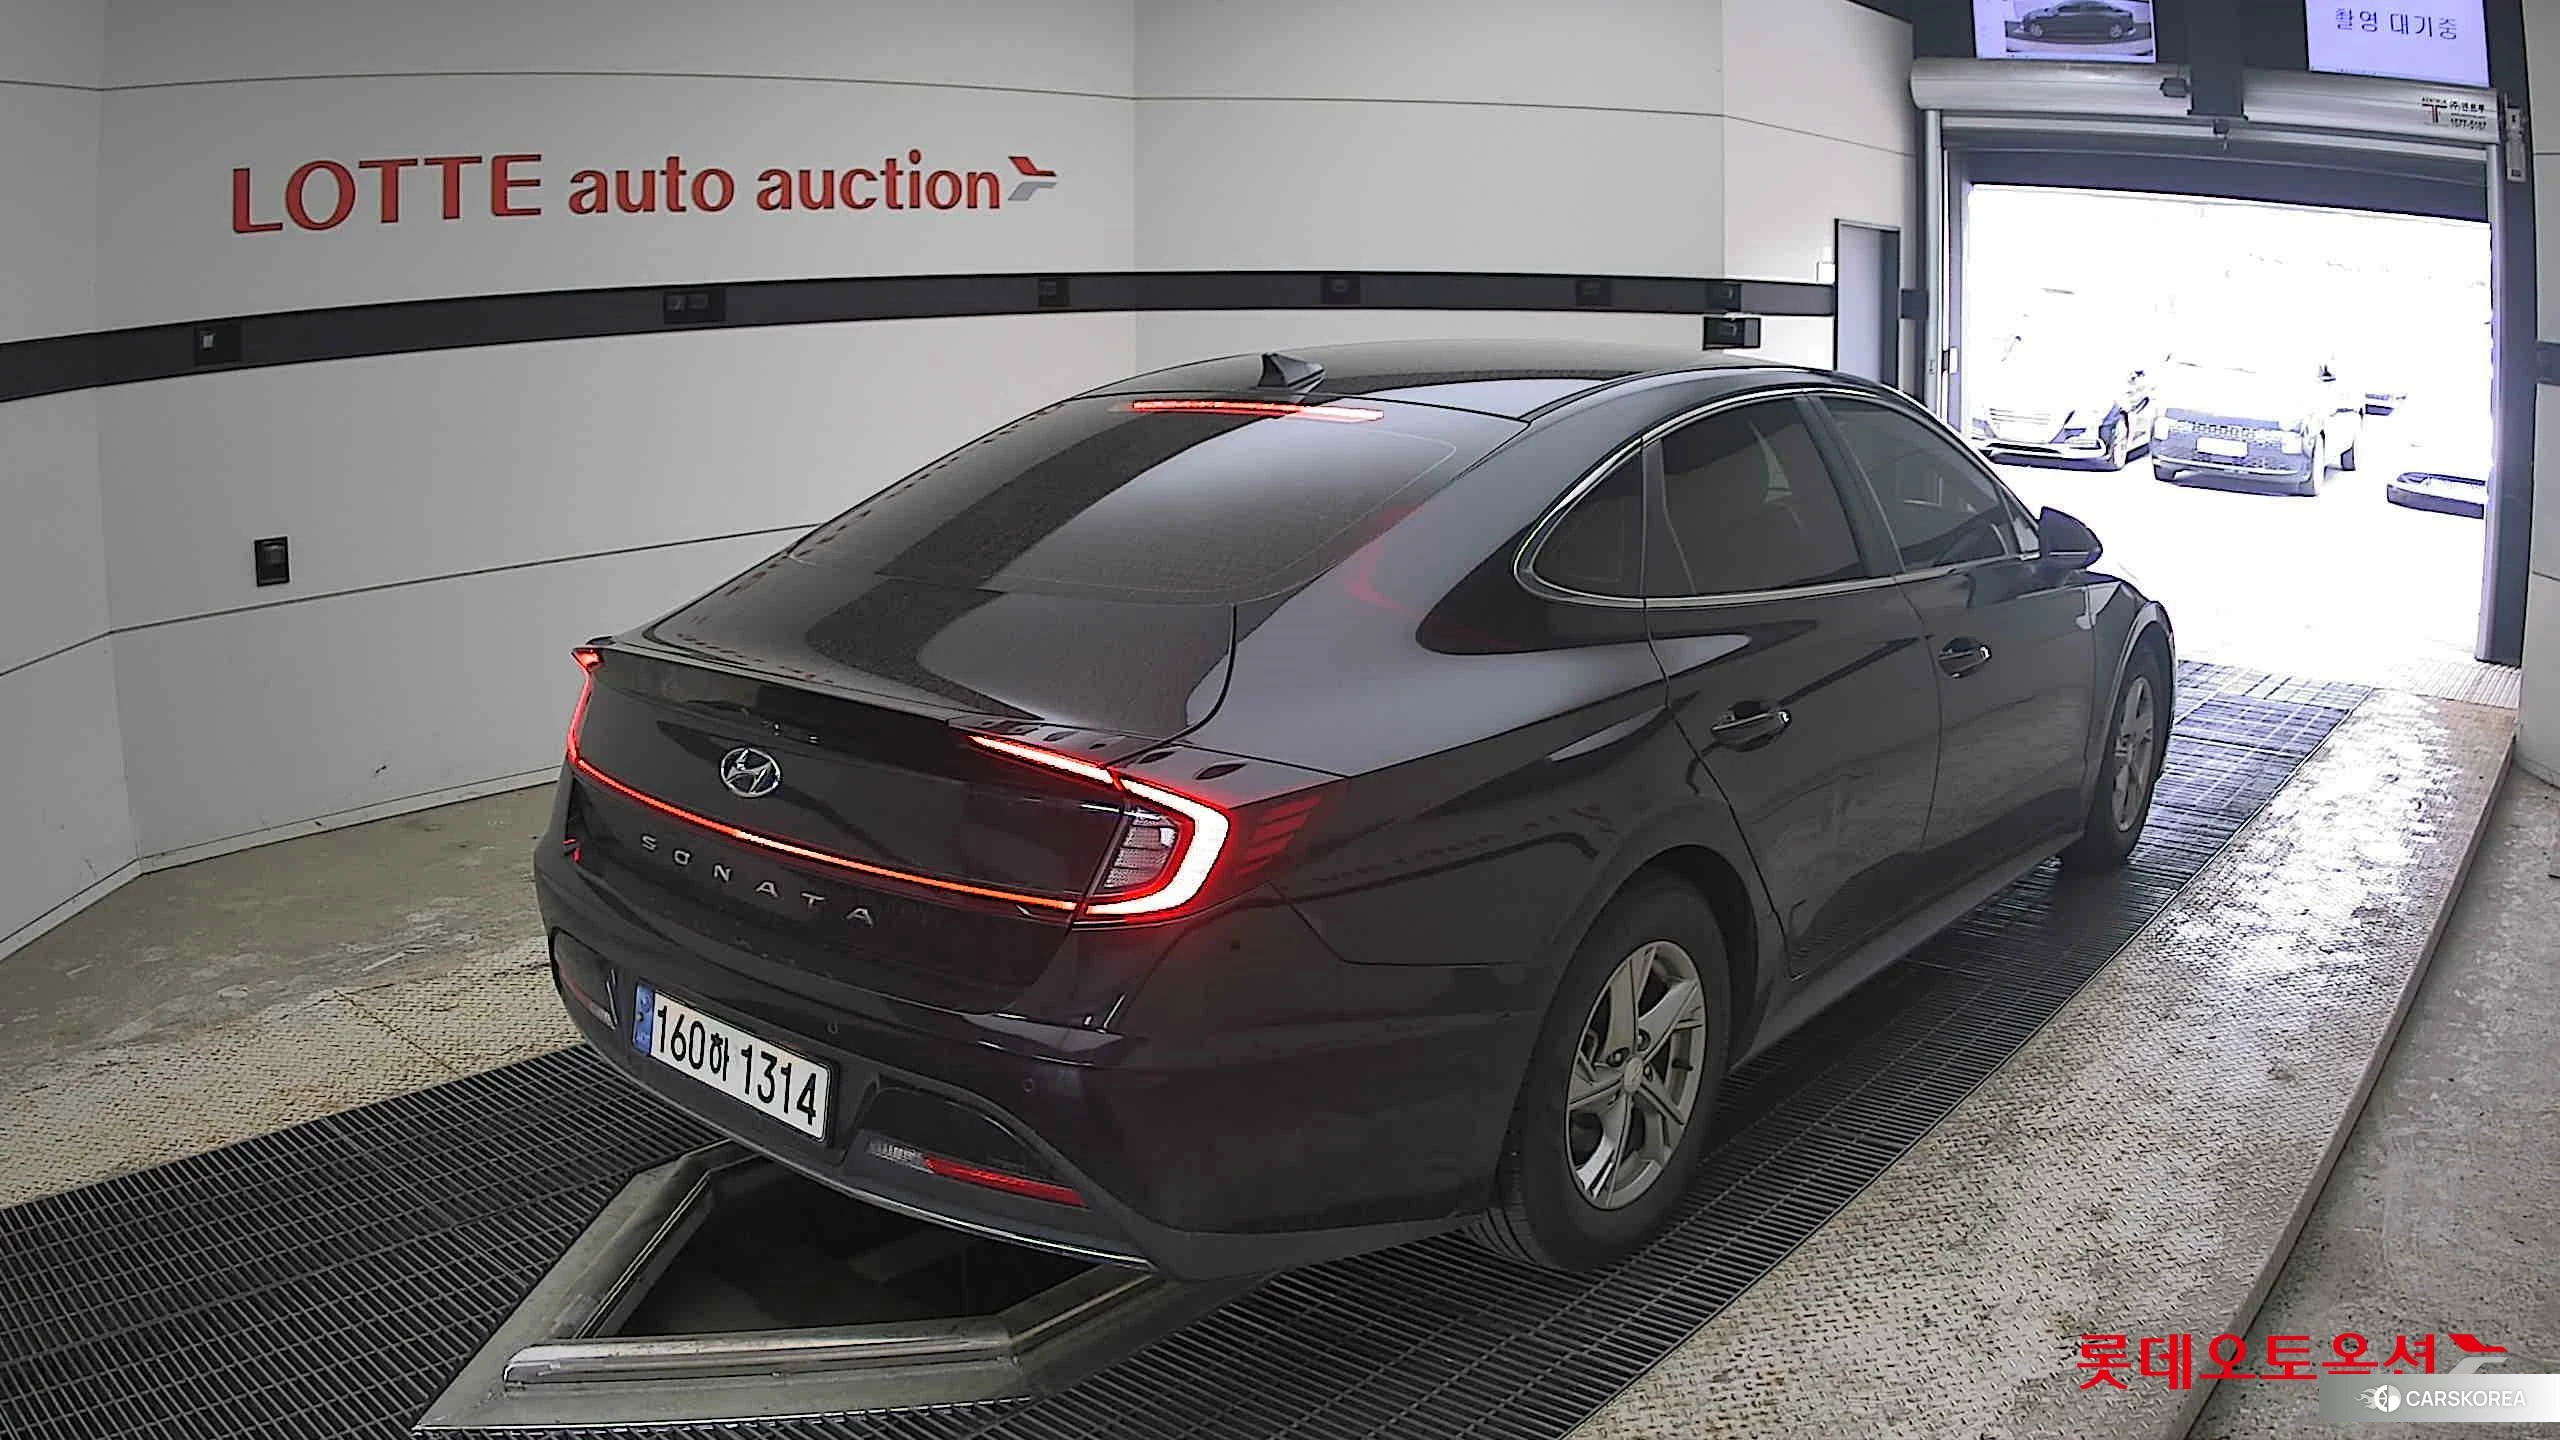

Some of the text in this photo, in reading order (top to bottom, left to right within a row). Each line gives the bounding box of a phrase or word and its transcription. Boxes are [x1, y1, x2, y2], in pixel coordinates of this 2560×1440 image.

[2336, 8, 2378, 33] 촬영
[232, 149, 1002, 233] LOTTE auto auction
[641, 834, 874, 927] SONATA
